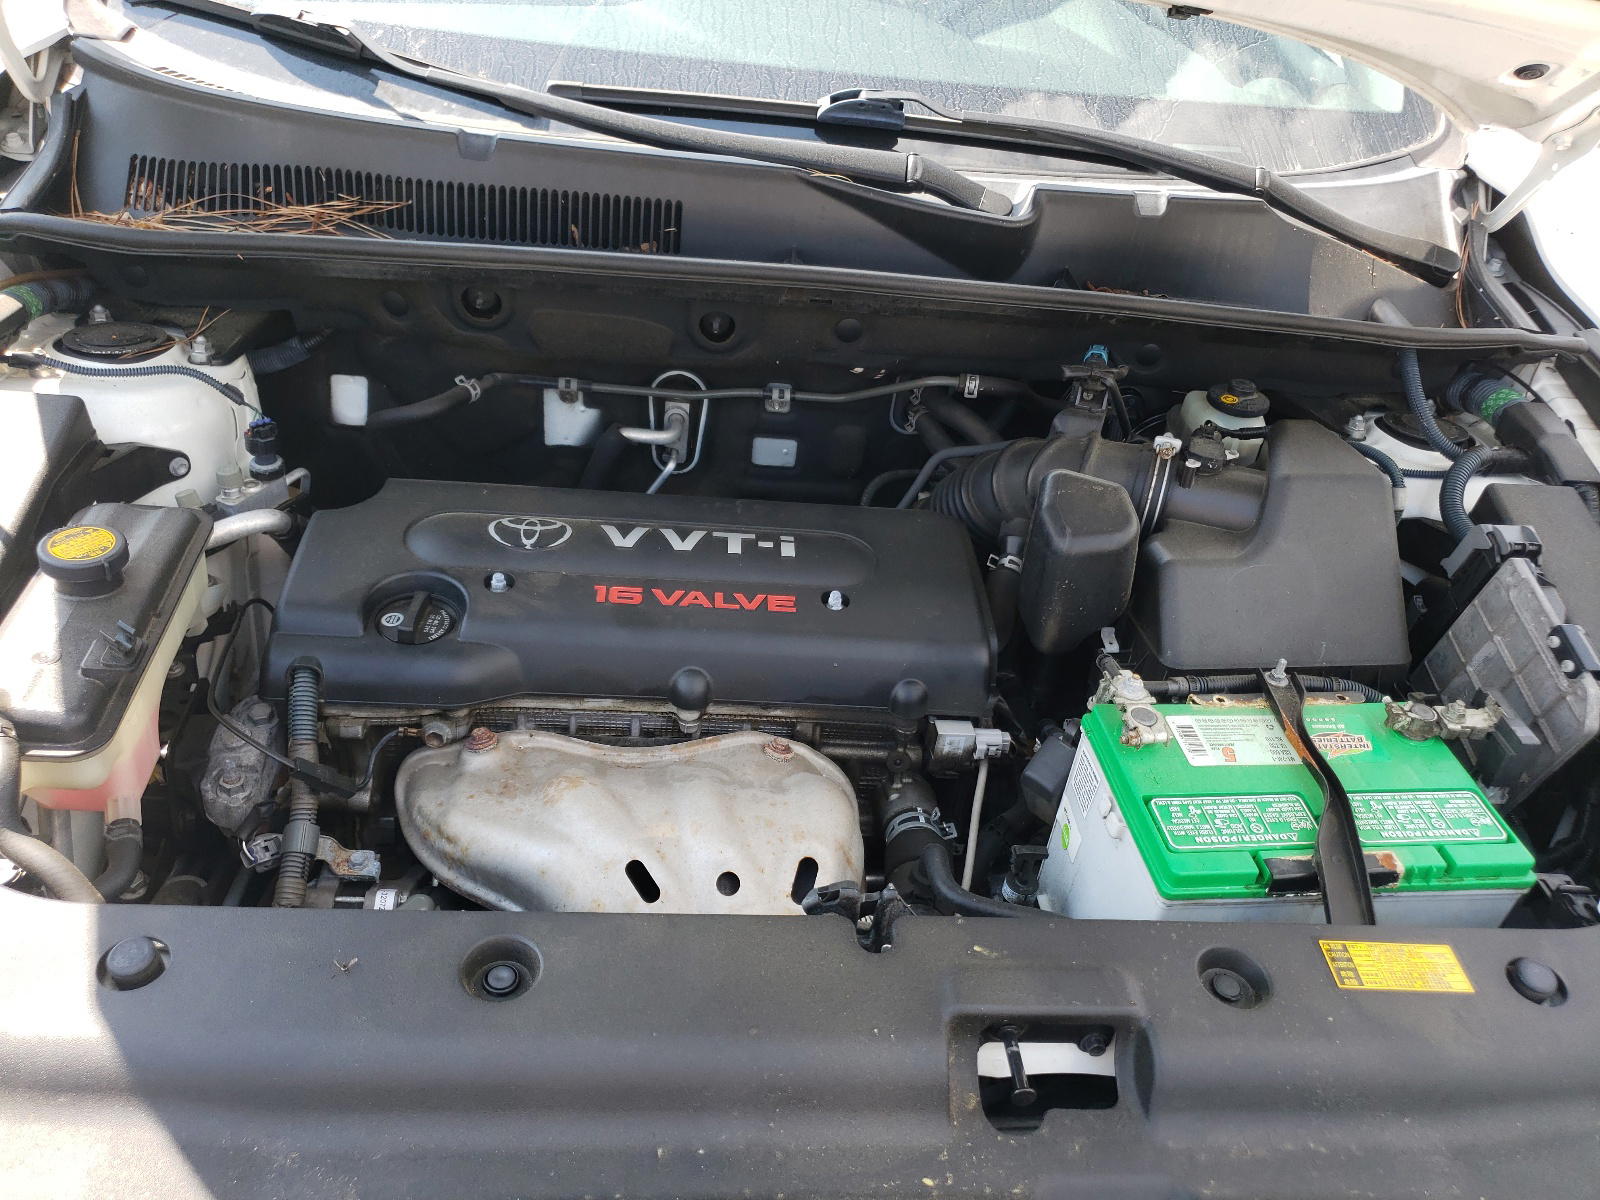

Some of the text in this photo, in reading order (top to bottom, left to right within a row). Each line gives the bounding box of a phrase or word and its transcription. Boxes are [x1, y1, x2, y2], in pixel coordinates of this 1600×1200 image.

[600, 524, 796, 557] VVT-i
[594, 586, 796, 612] 16 VALVE
[1312, 736, 1364, 744] BATTERIES
[1222, 747, 1236, 762] 5
[1194, 832, 1288, 843] DANGER/POISON
[1380, 828, 1468, 838] DANGER/POISON
